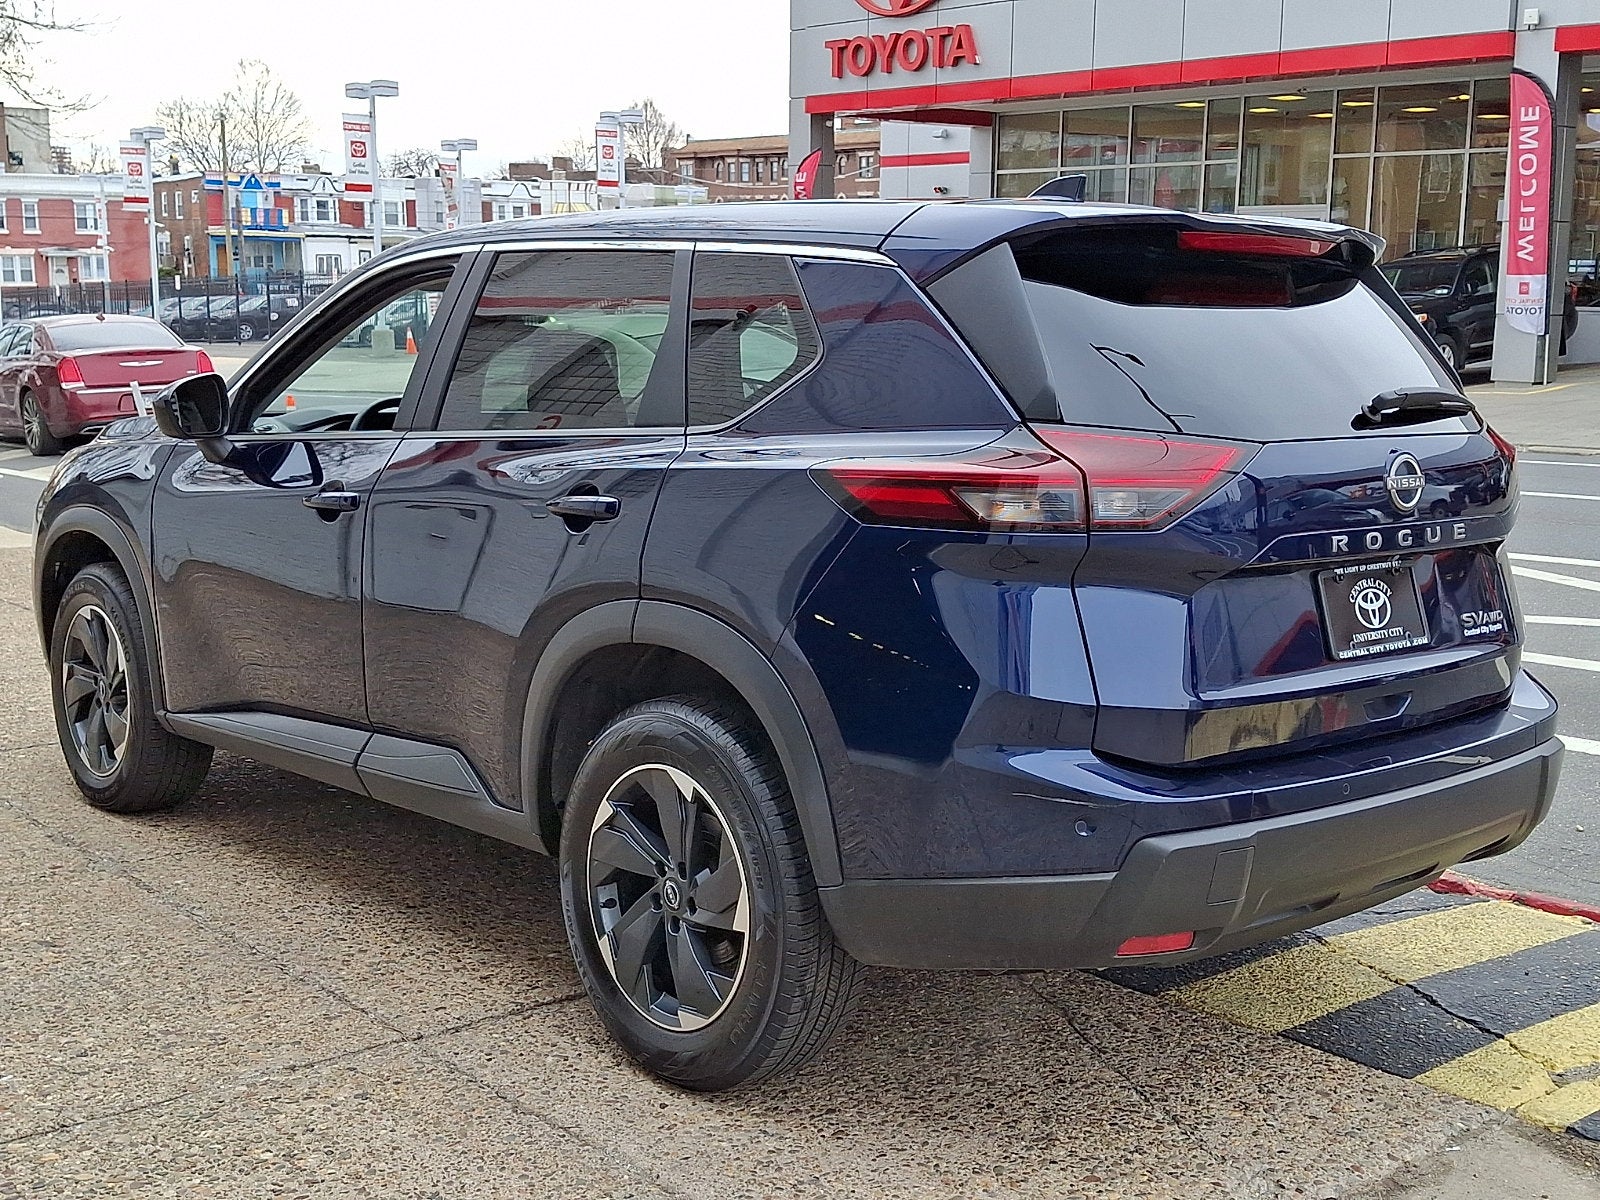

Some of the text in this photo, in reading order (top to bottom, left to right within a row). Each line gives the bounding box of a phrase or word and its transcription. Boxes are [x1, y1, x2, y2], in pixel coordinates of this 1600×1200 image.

[825, 24, 980, 78] TOYOTA
[1388, 477, 1425, 488] NISSAN
[1331, 522, 1466, 553] ROGUE
[1349, 577, 1393, 603] CENTRAL CITY
[1353, 626, 1404, 643] UNIVERSITY CITY
[1339, 648, 1369, 660] CENTRAL
[1369, 644, 1385, 654] CITY
[1385, 639, 1411, 652] TOYOTA
